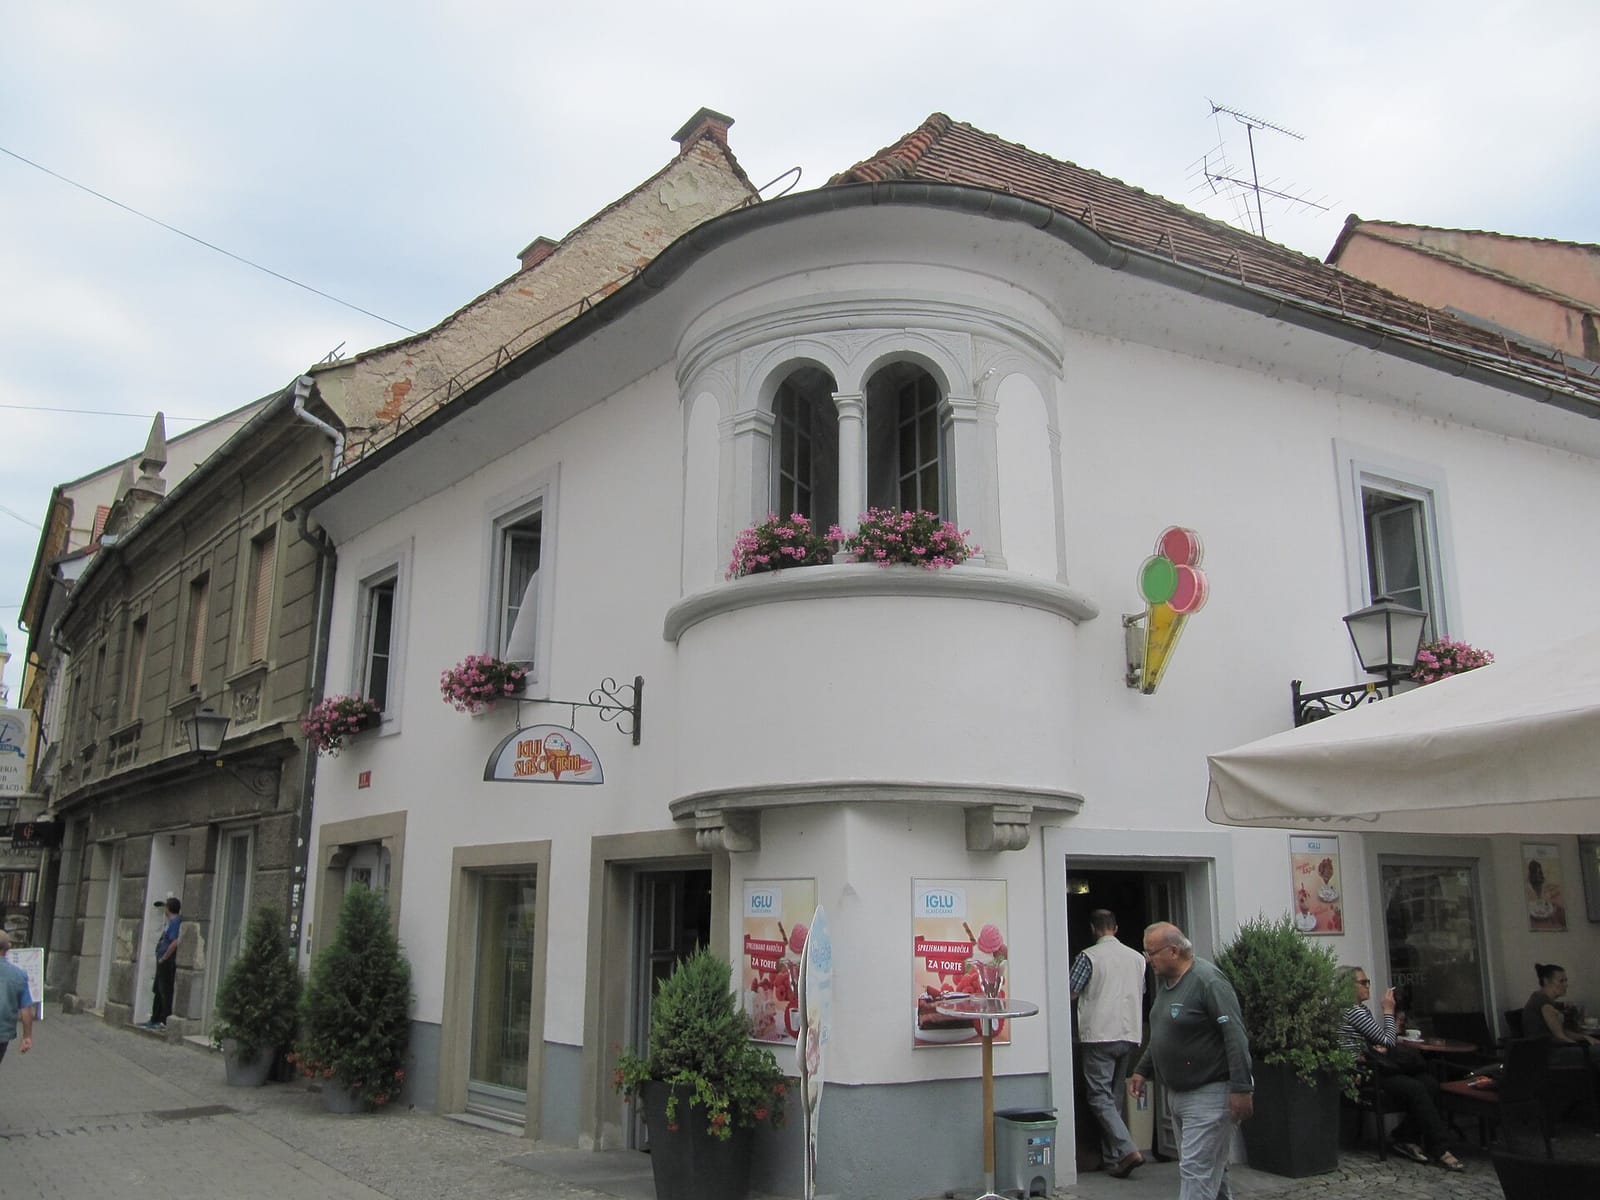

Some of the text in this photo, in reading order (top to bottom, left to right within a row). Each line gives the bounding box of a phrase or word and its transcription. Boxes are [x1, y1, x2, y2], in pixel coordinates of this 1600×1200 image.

[517, 739, 542, 758] IGLU
[751, 895, 772, 908] IGLU
[926, 895, 953, 908] IGLU
[752, 957, 777, 970] ZA TORTE
[928, 960, 962, 971] ZA TORTE
